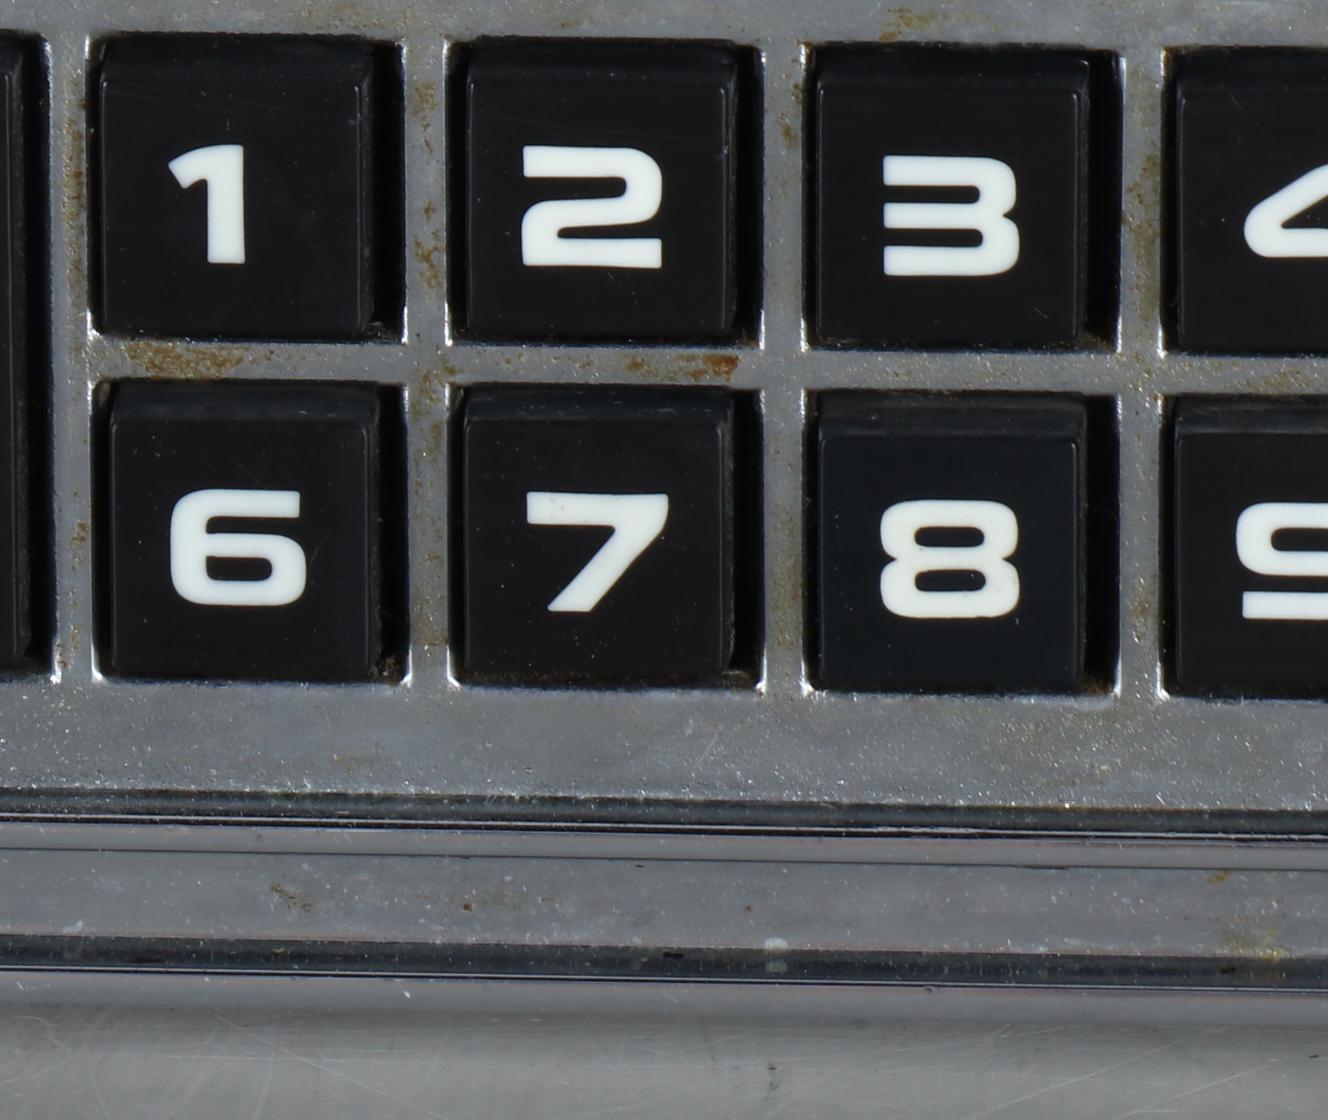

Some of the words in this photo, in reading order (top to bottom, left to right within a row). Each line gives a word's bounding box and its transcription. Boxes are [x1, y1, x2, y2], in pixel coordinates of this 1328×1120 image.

[169, 145, 246, 264] 1
[521, 146, 663, 269] 2
[883, 155, 1020, 276] 3
[170, 489, 307, 606] 6
[526, 491, 669, 612] 7
[880, 500, 1020, 619] 8
